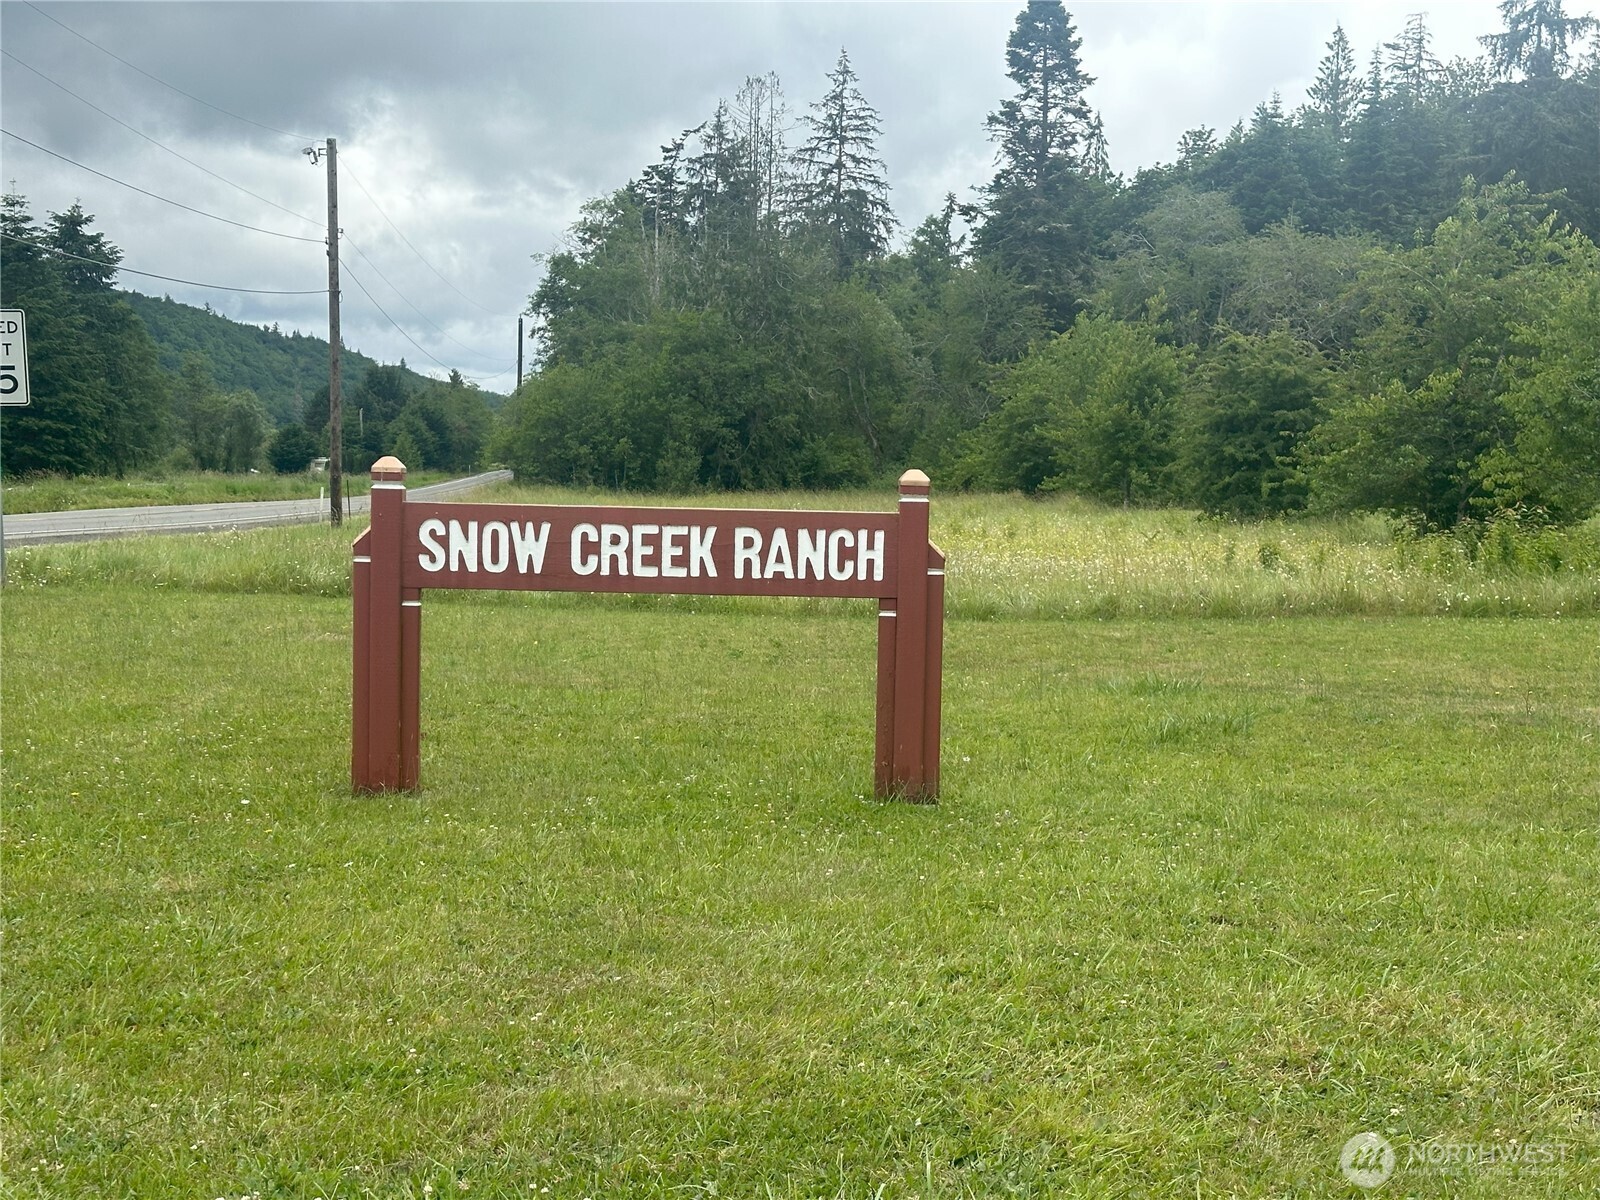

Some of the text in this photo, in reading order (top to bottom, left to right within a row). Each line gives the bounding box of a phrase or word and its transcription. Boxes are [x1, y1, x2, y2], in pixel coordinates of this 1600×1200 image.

[418, 518, 886, 582] SNOW CREEK RANCH
